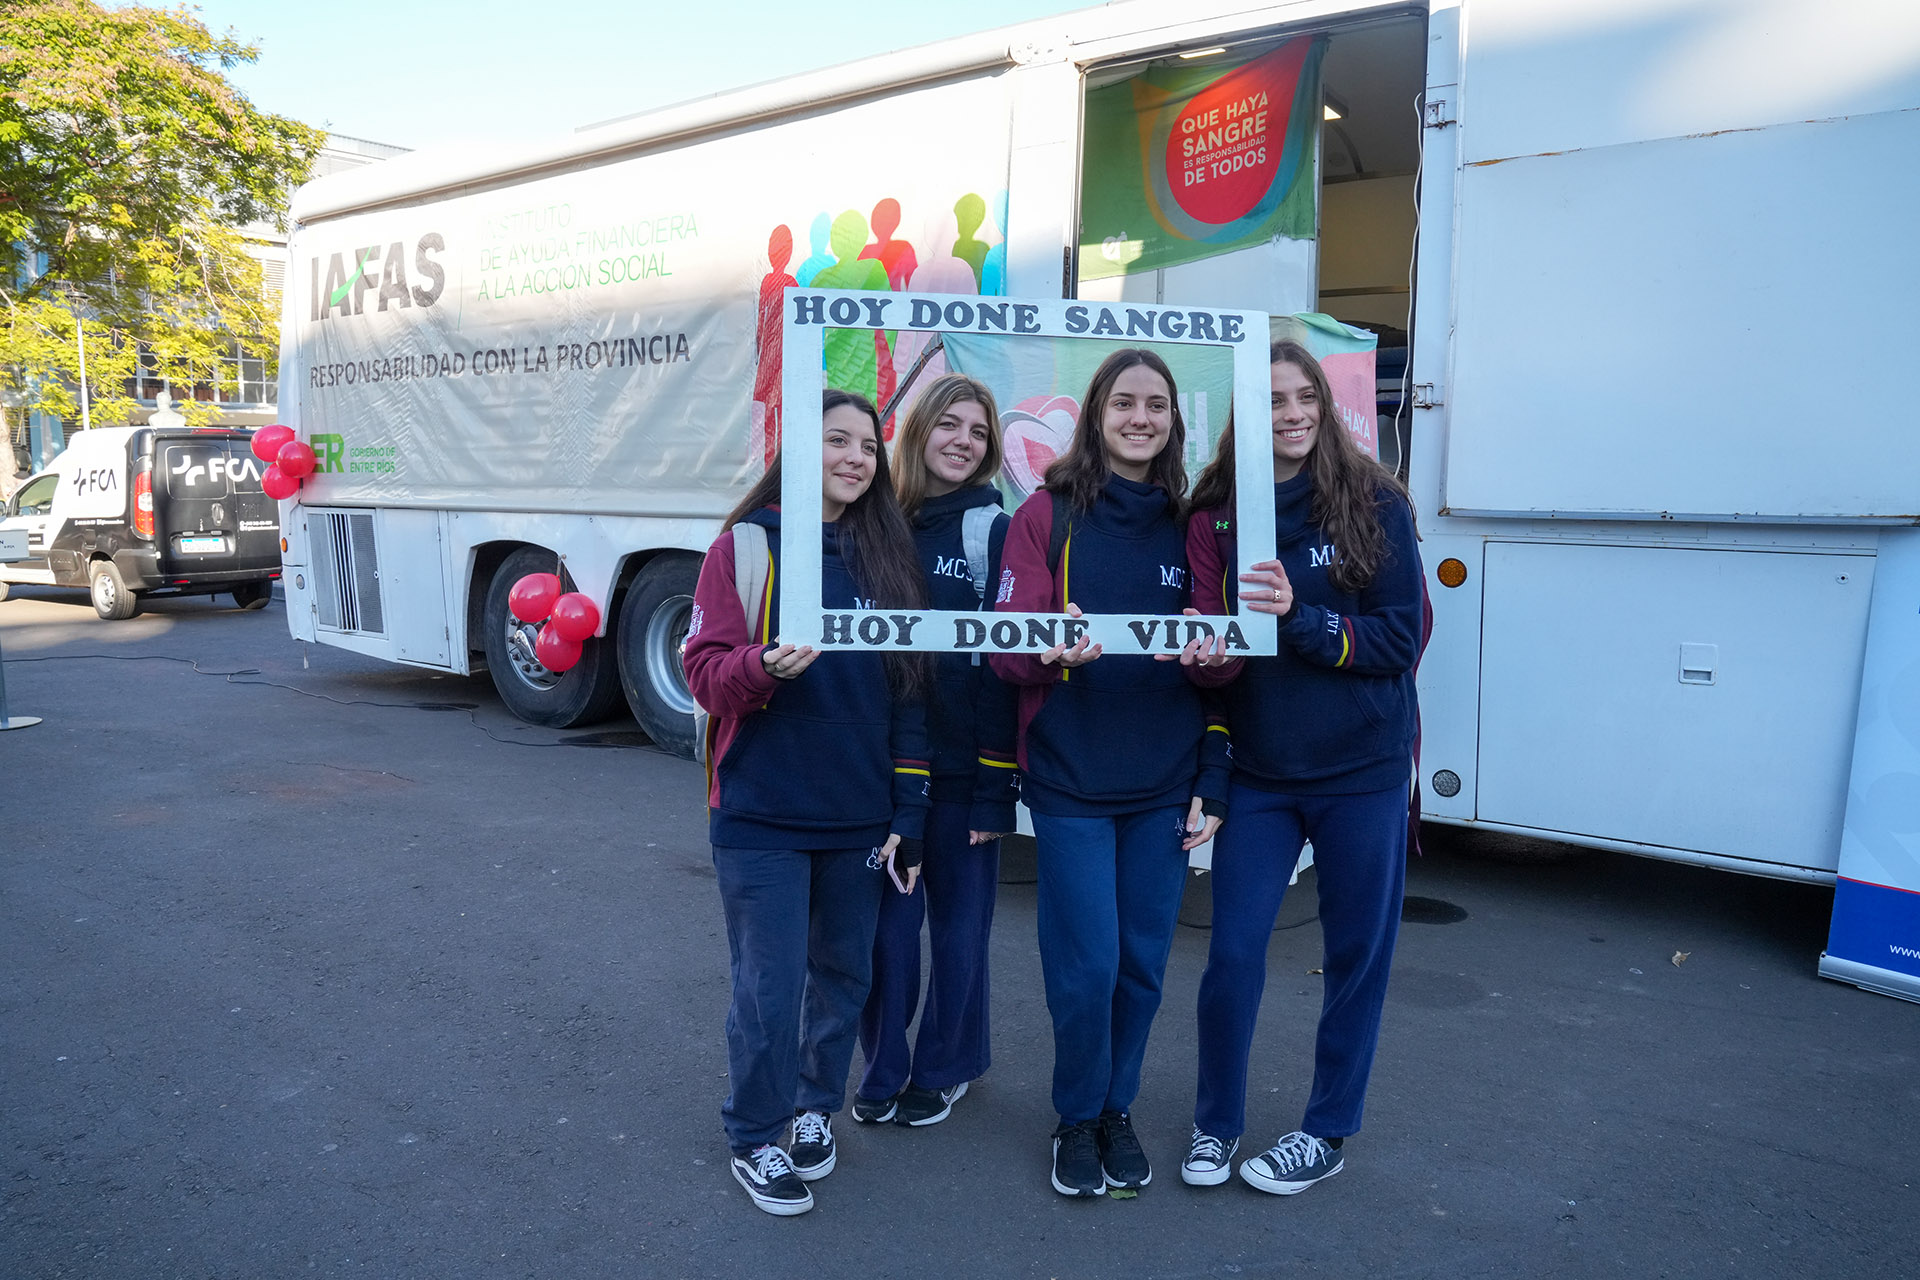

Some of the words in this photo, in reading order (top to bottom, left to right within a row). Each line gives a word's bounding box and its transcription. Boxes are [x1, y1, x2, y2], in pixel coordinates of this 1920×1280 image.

[1182, 108, 1219, 134] QUE
[1226, 90, 1268, 121] HAYA
[1183, 110, 1268, 158] SANGRE
[1184, 159, 1194, 169] ES
[1196, 135, 1266, 166] RESPONSABILIDAD
[1184, 166, 1206, 187] DE
[1210, 147, 1266, 179] TODOS
[480, 246, 502, 272] DE
[508, 236, 570, 267] AYUDA
[575, 212, 699, 257] FINANCIERA
[481, 203, 572, 241] INSTITUTO
[310, 232, 446, 322] IAFAS
[478, 279, 490, 301] A
[495, 274, 516, 299] LA
[598, 252, 673, 286] SOCIAL
[793, 296, 893, 328] HOY
[908, 298, 1041, 335] DONE
[1065, 305, 1246, 343] SANGRE
[310, 352, 466, 389] RESPONSABILIDAD
[472, 348, 516, 376] CON
[523, 346, 549, 373] LA
[556, 333, 691, 371] PROVINCIA
[1343, 406, 1371, 441] HAYA
[208, 457, 261, 483] FCA
[310, 433, 345, 473] ER
[350, 447, 384, 458] GOBIERNO
[350, 461, 375, 473] ENTRE
[820, 614, 922, 646] HOY
[953, 618, 1090, 651] DONE
[1127, 620, 1251, 651] VIDA
